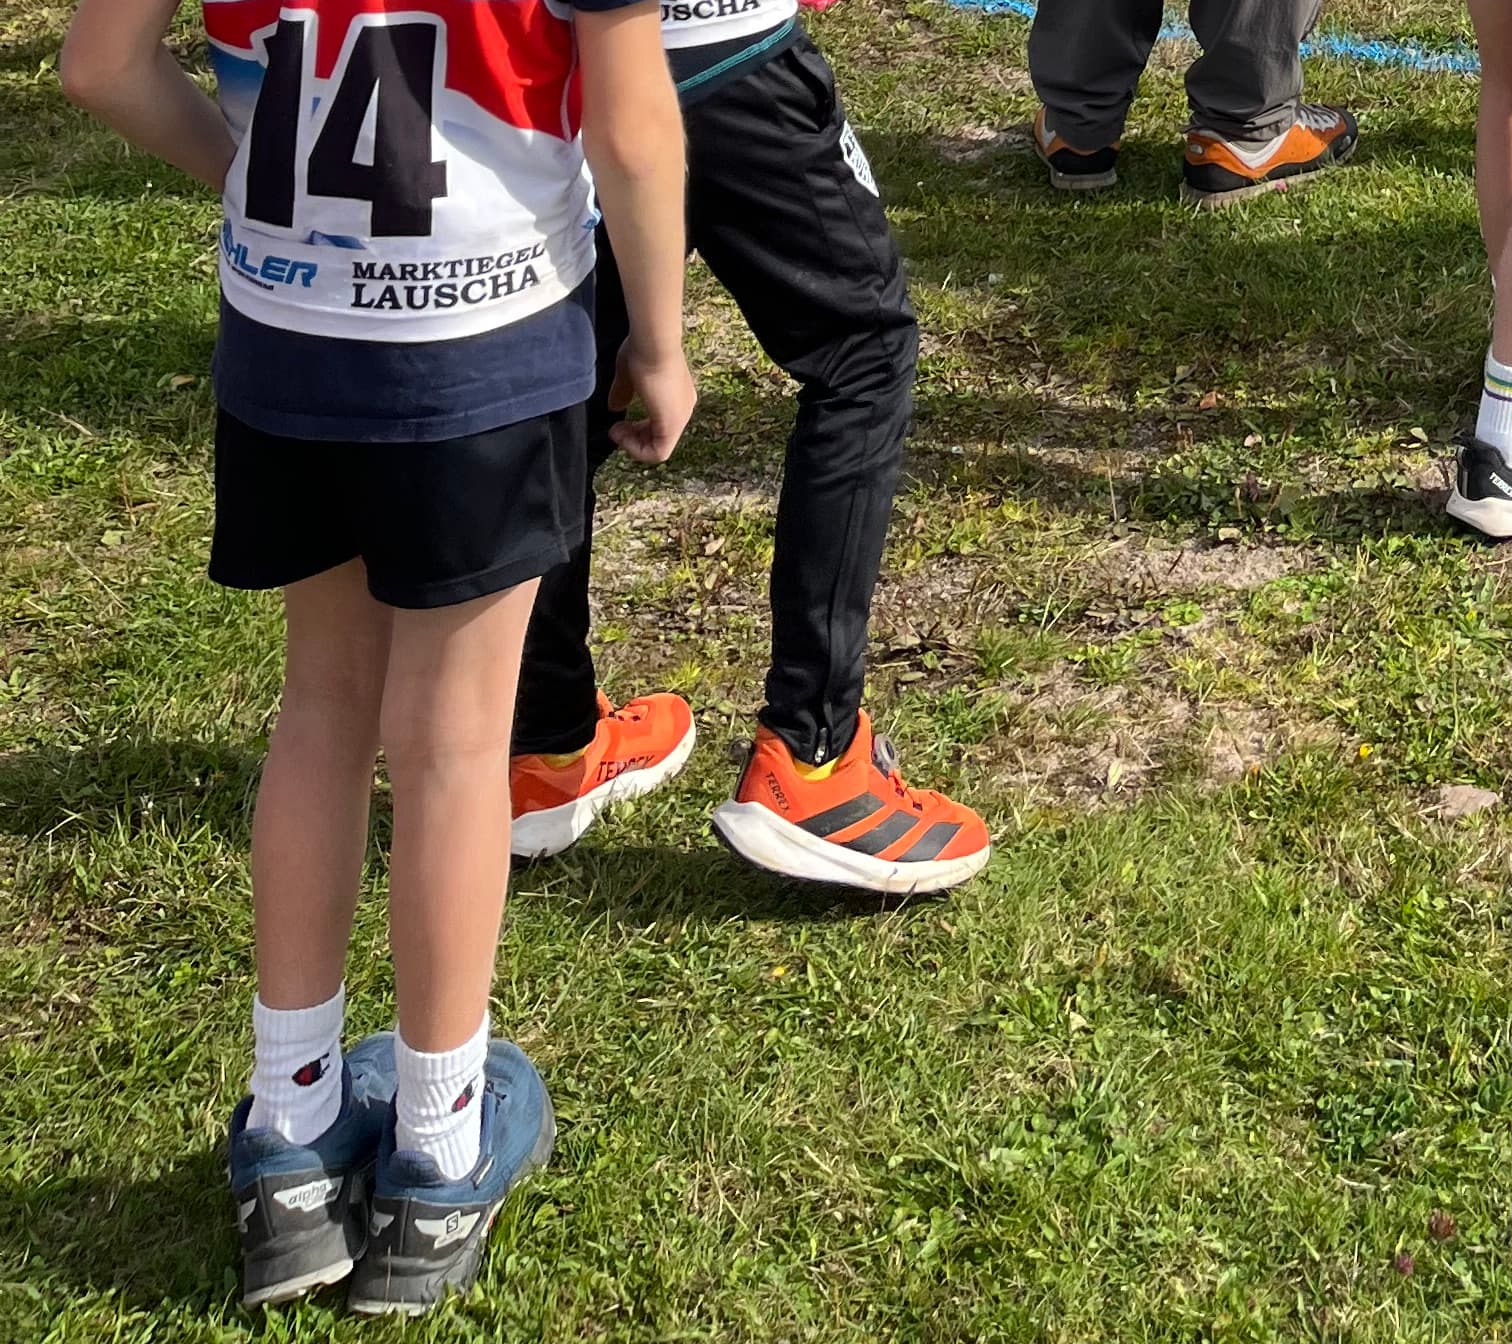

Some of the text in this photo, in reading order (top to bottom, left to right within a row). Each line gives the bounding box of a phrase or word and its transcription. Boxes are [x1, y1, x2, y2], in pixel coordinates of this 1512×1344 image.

[245, 19, 447, 237] 14
[352, 243, 545, 281] MARKTIEGEL
[351, 264, 542, 310] LAUSCHA
[288, 1183, 327, 1205] alpha
